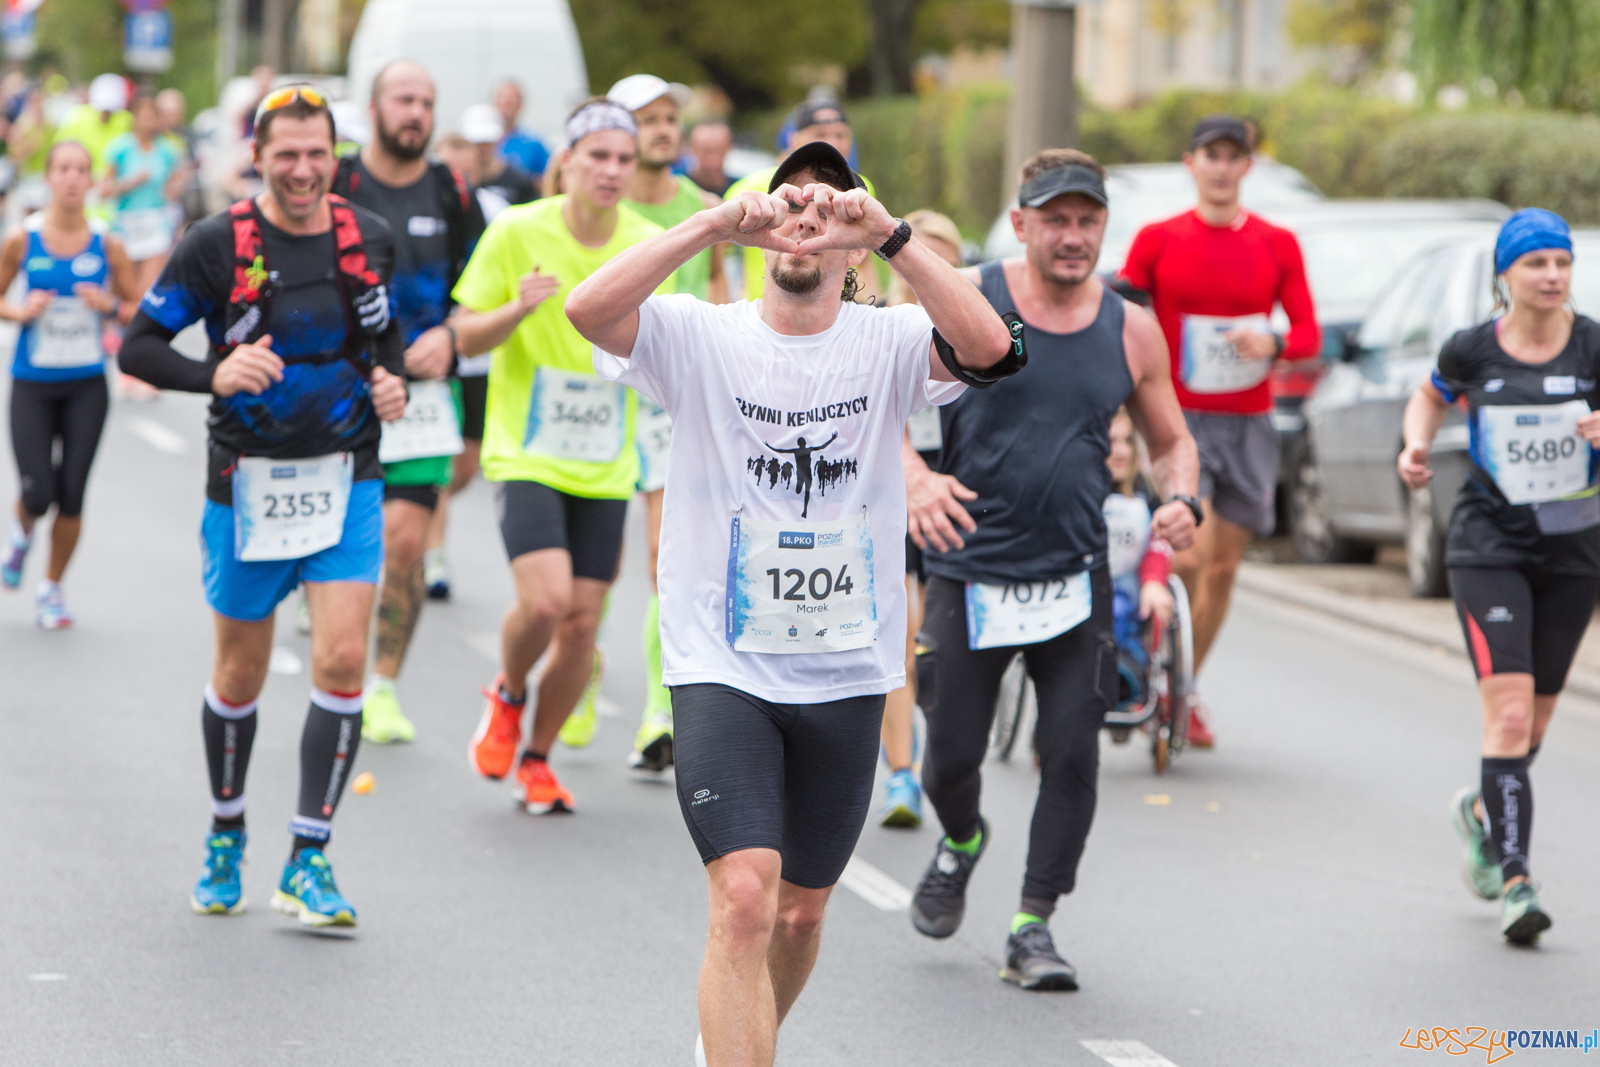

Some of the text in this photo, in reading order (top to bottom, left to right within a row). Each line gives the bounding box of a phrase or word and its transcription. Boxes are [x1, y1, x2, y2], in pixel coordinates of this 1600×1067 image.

[787, 396, 868, 427] KENIJCZYCY
[1508, 436, 1575, 463] 5680
[264, 491, 331, 519] 2353
[817, 537, 843, 545] maraton
[766, 564, 853, 601] 1204
[796, 603, 829, 614] Marek
